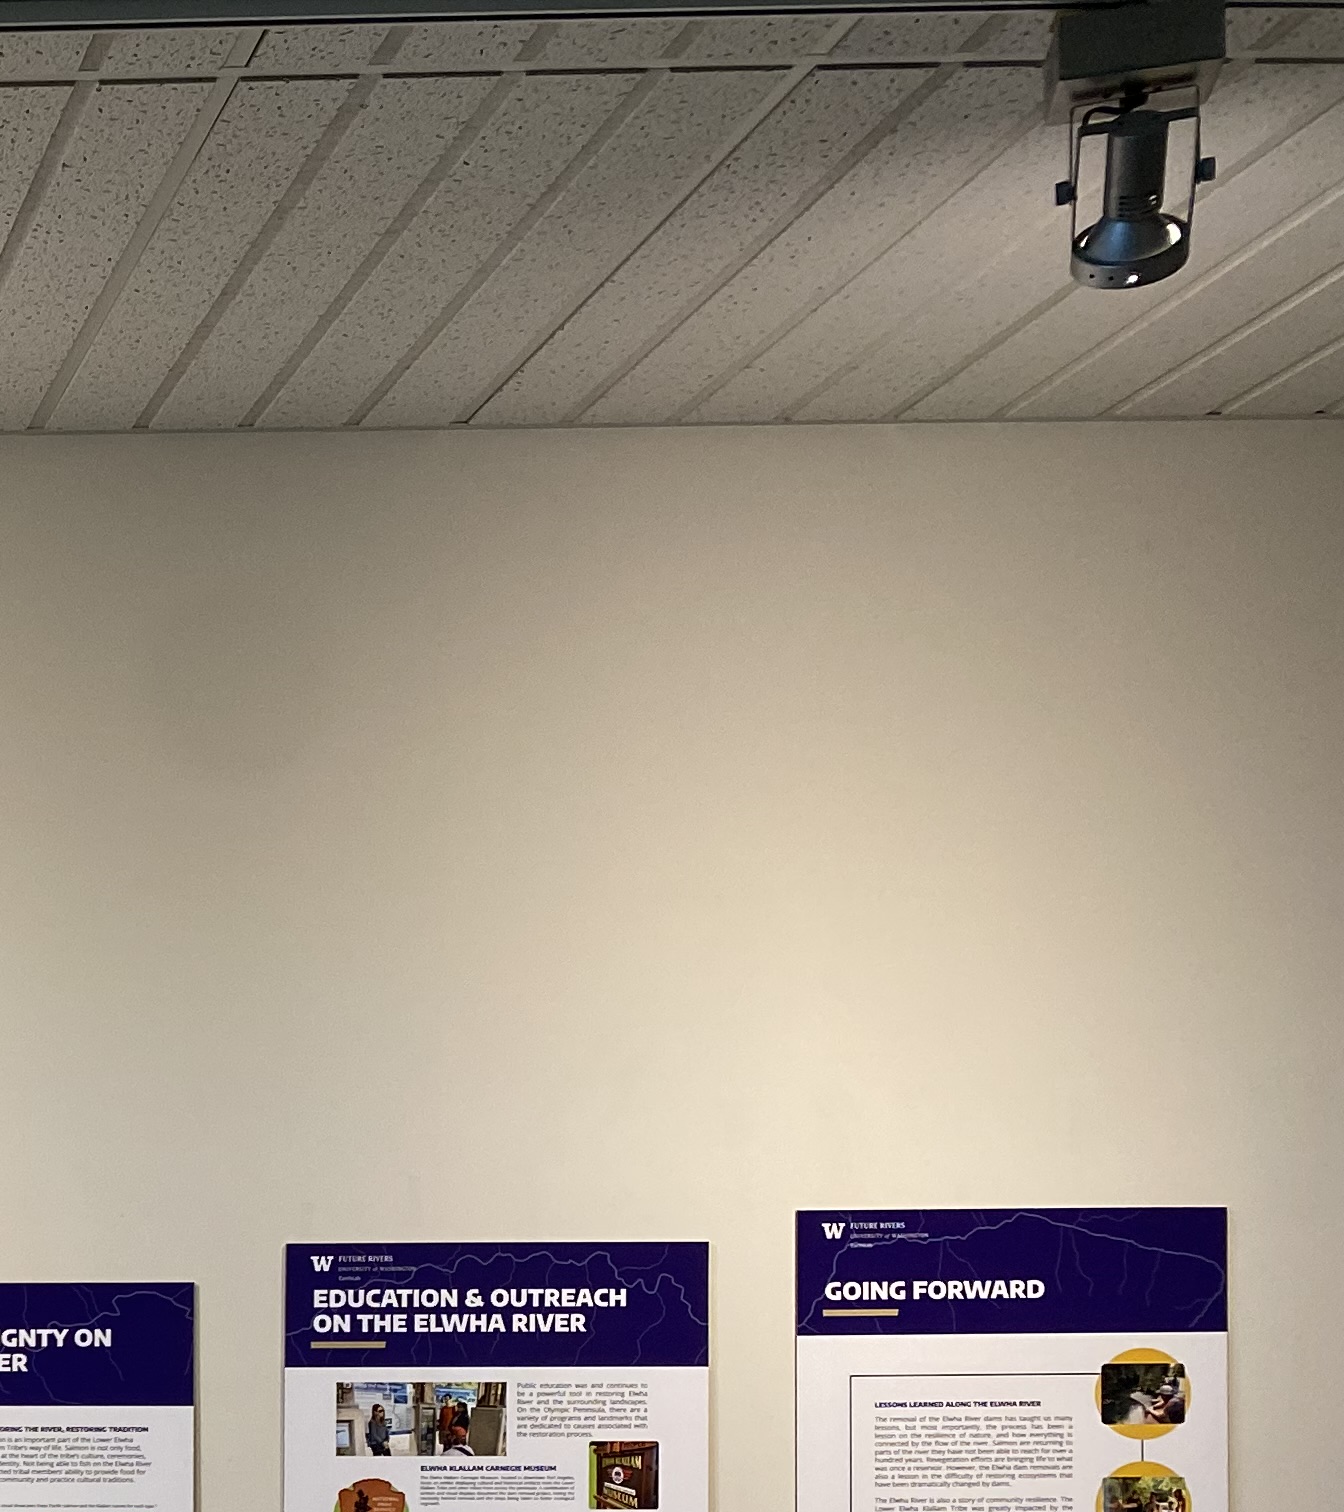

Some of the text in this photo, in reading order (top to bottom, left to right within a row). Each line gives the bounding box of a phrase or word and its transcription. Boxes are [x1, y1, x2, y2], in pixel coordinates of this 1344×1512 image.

[822, 1223, 845, 1239] W
[849, 1221, 906, 1230] FUTURE RIVERS
[310, 1256, 334, 1271] W
[338, 1255, 394, 1263] FUTURE RIVERS
[314, 1288, 626, 1308] EDUCATION & OUTREACH
[825, 1280, 1045, 1300] GOING FORWARD
[313, 1314, 586, 1332] ON THE ELWHA RIVER
[75, 1329, 111, 1347] ON
[874, 1401, 908, 1409] LESSONS
[972, 1400, 988, 1408] THE
[989, 1400, 1018, 1408] ELWHA
